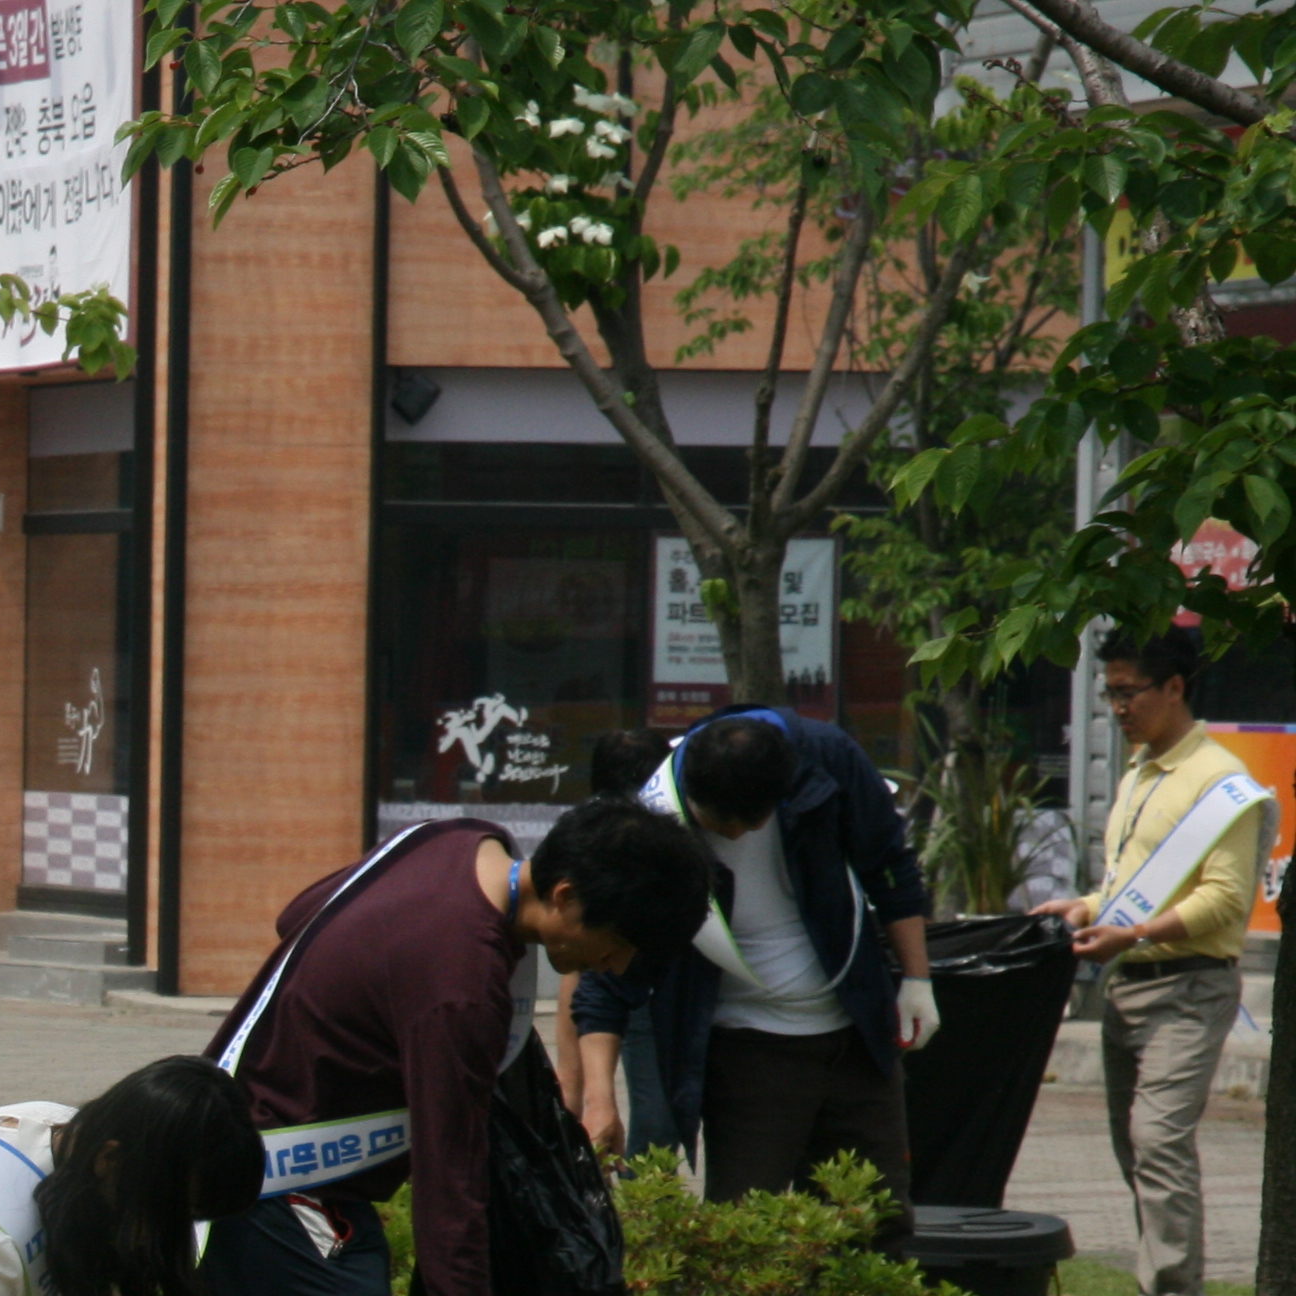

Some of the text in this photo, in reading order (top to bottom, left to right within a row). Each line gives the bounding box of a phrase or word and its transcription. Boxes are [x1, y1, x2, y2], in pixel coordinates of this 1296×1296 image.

[36, 97, 66, 155] 충북
[779, 601, 820, 627] 모집
[1221, 782, 1249, 806] ITM
[1125, 888, 1155, 914] ITM
[24, 1227, 47, 1265] IT
